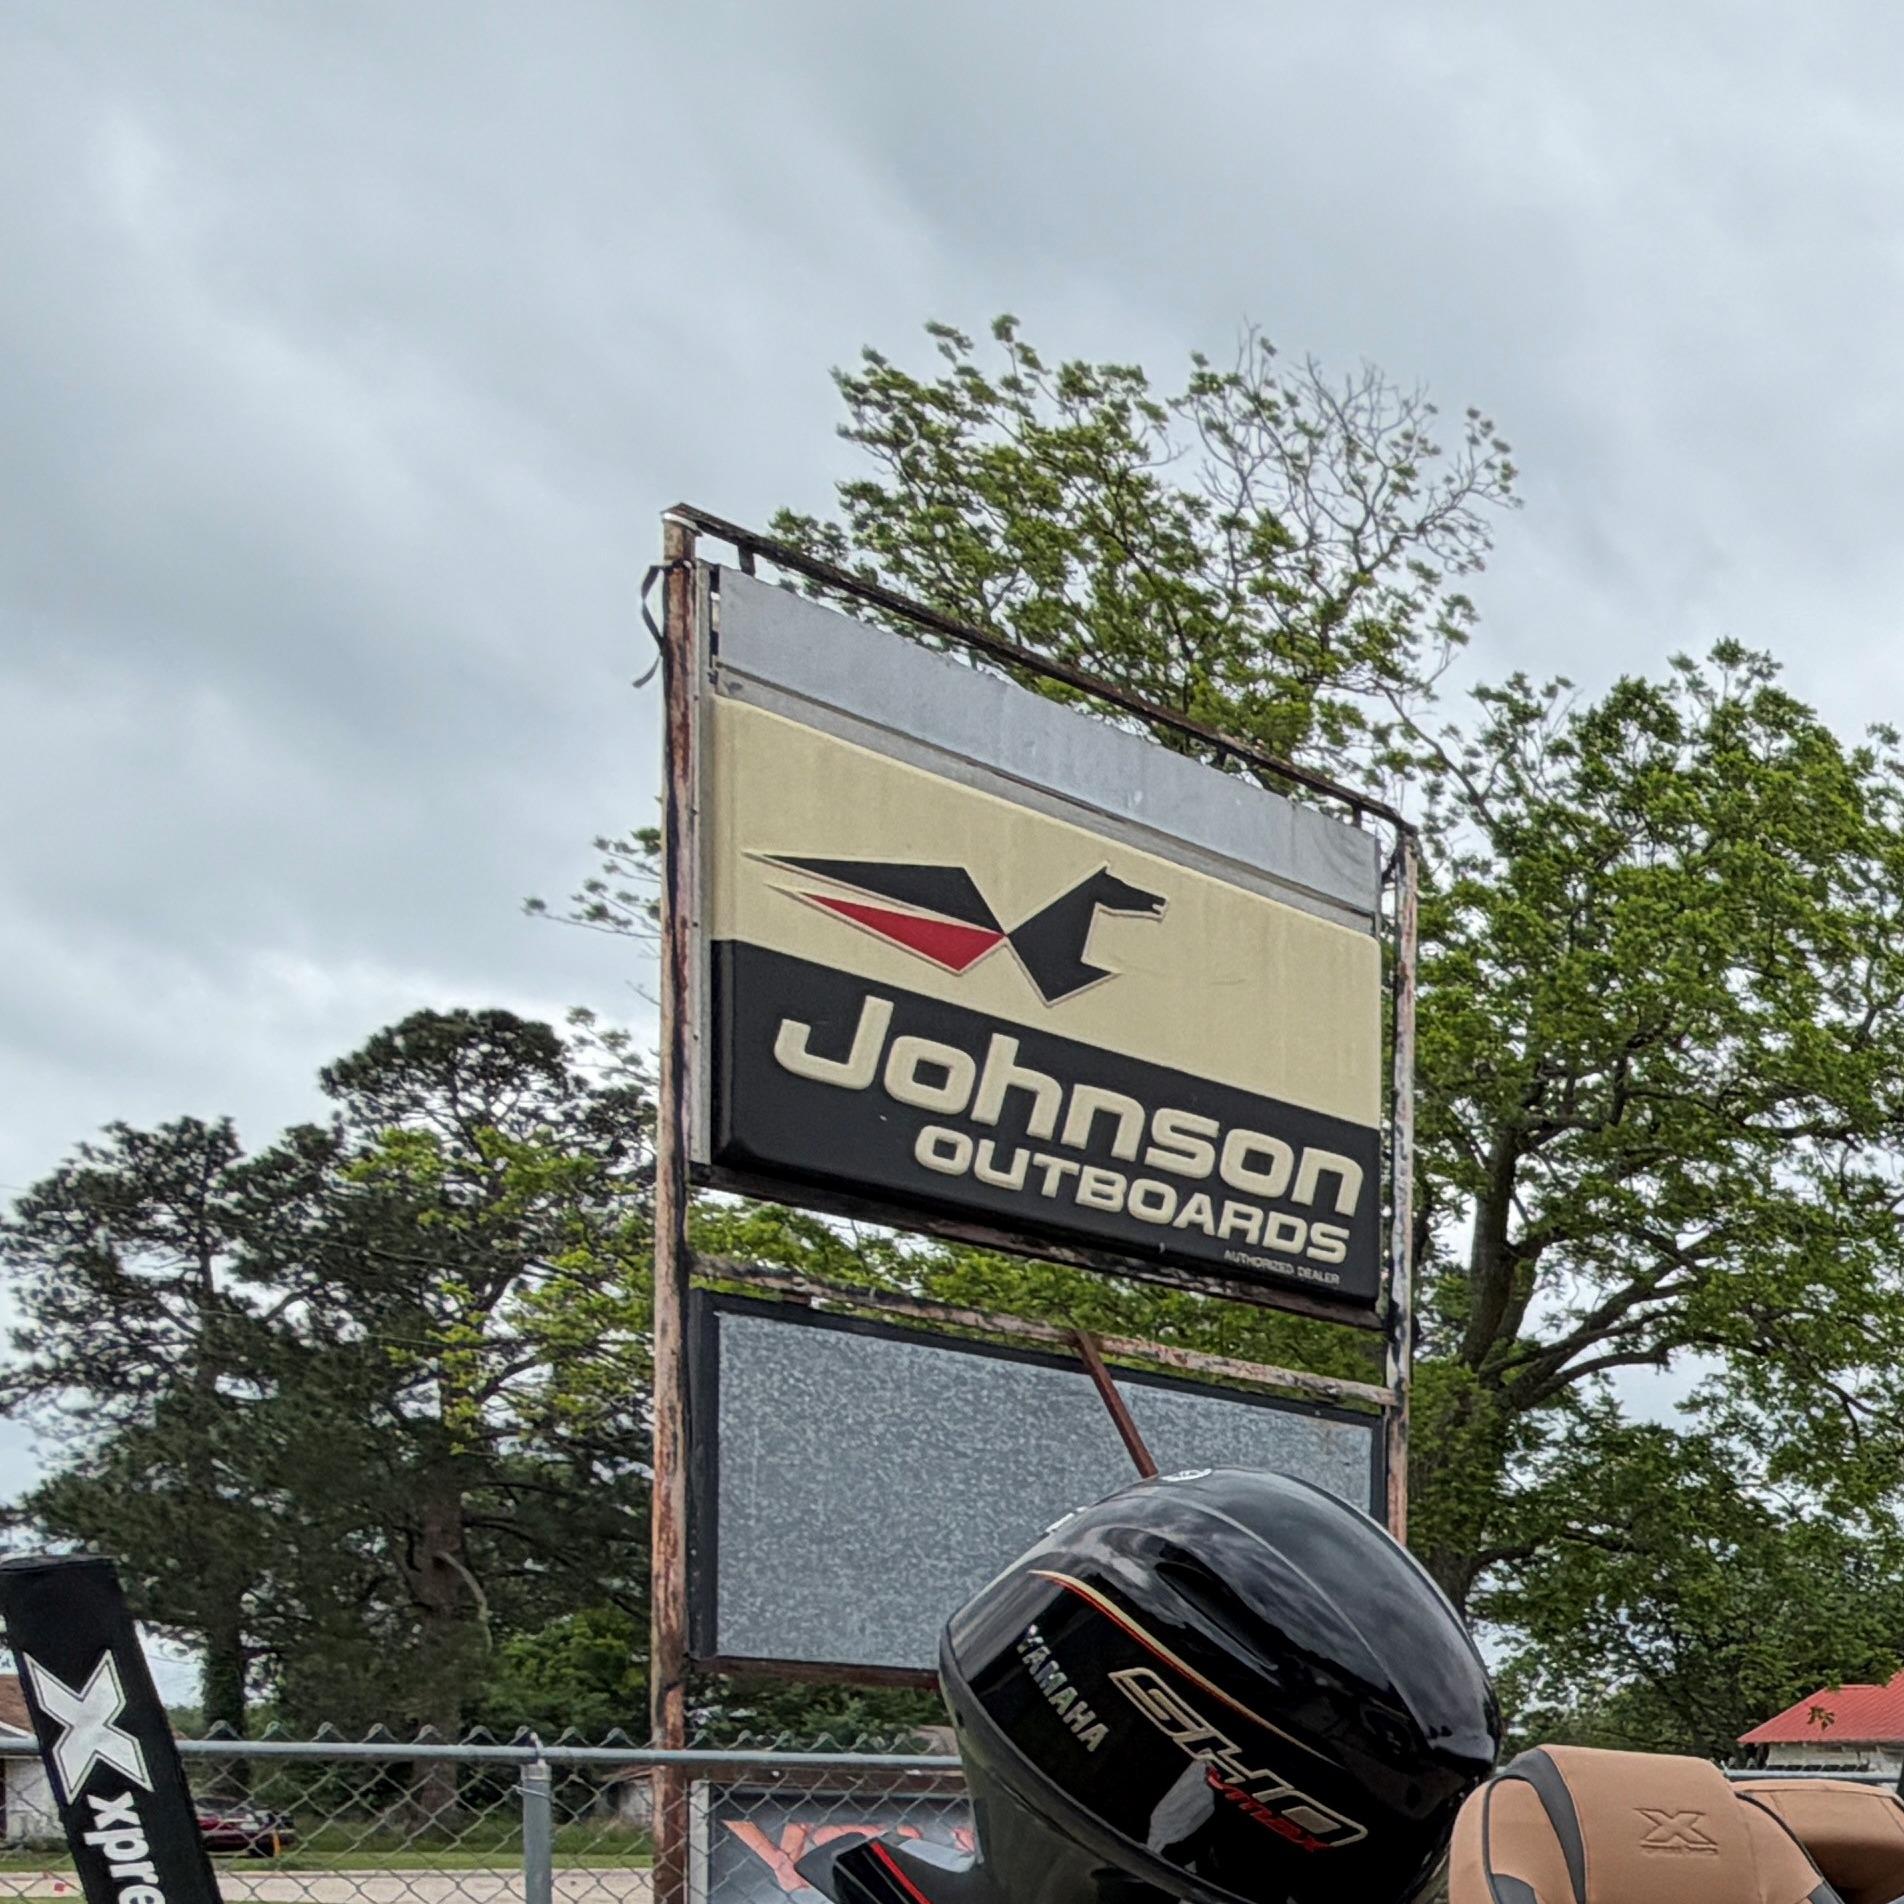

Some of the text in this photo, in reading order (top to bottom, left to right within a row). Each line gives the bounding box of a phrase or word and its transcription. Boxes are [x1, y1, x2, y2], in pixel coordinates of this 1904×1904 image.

[774, 994, 1364, 1218] Johnson
[914, 1124, 1350, 1265] OUTBOARDS
[1297, 1266, 1340, 1285] DEALER
[1017, 1624, 1111, 1753] YAMAHA
[1107, 1667, 1369, 1847] SHO
